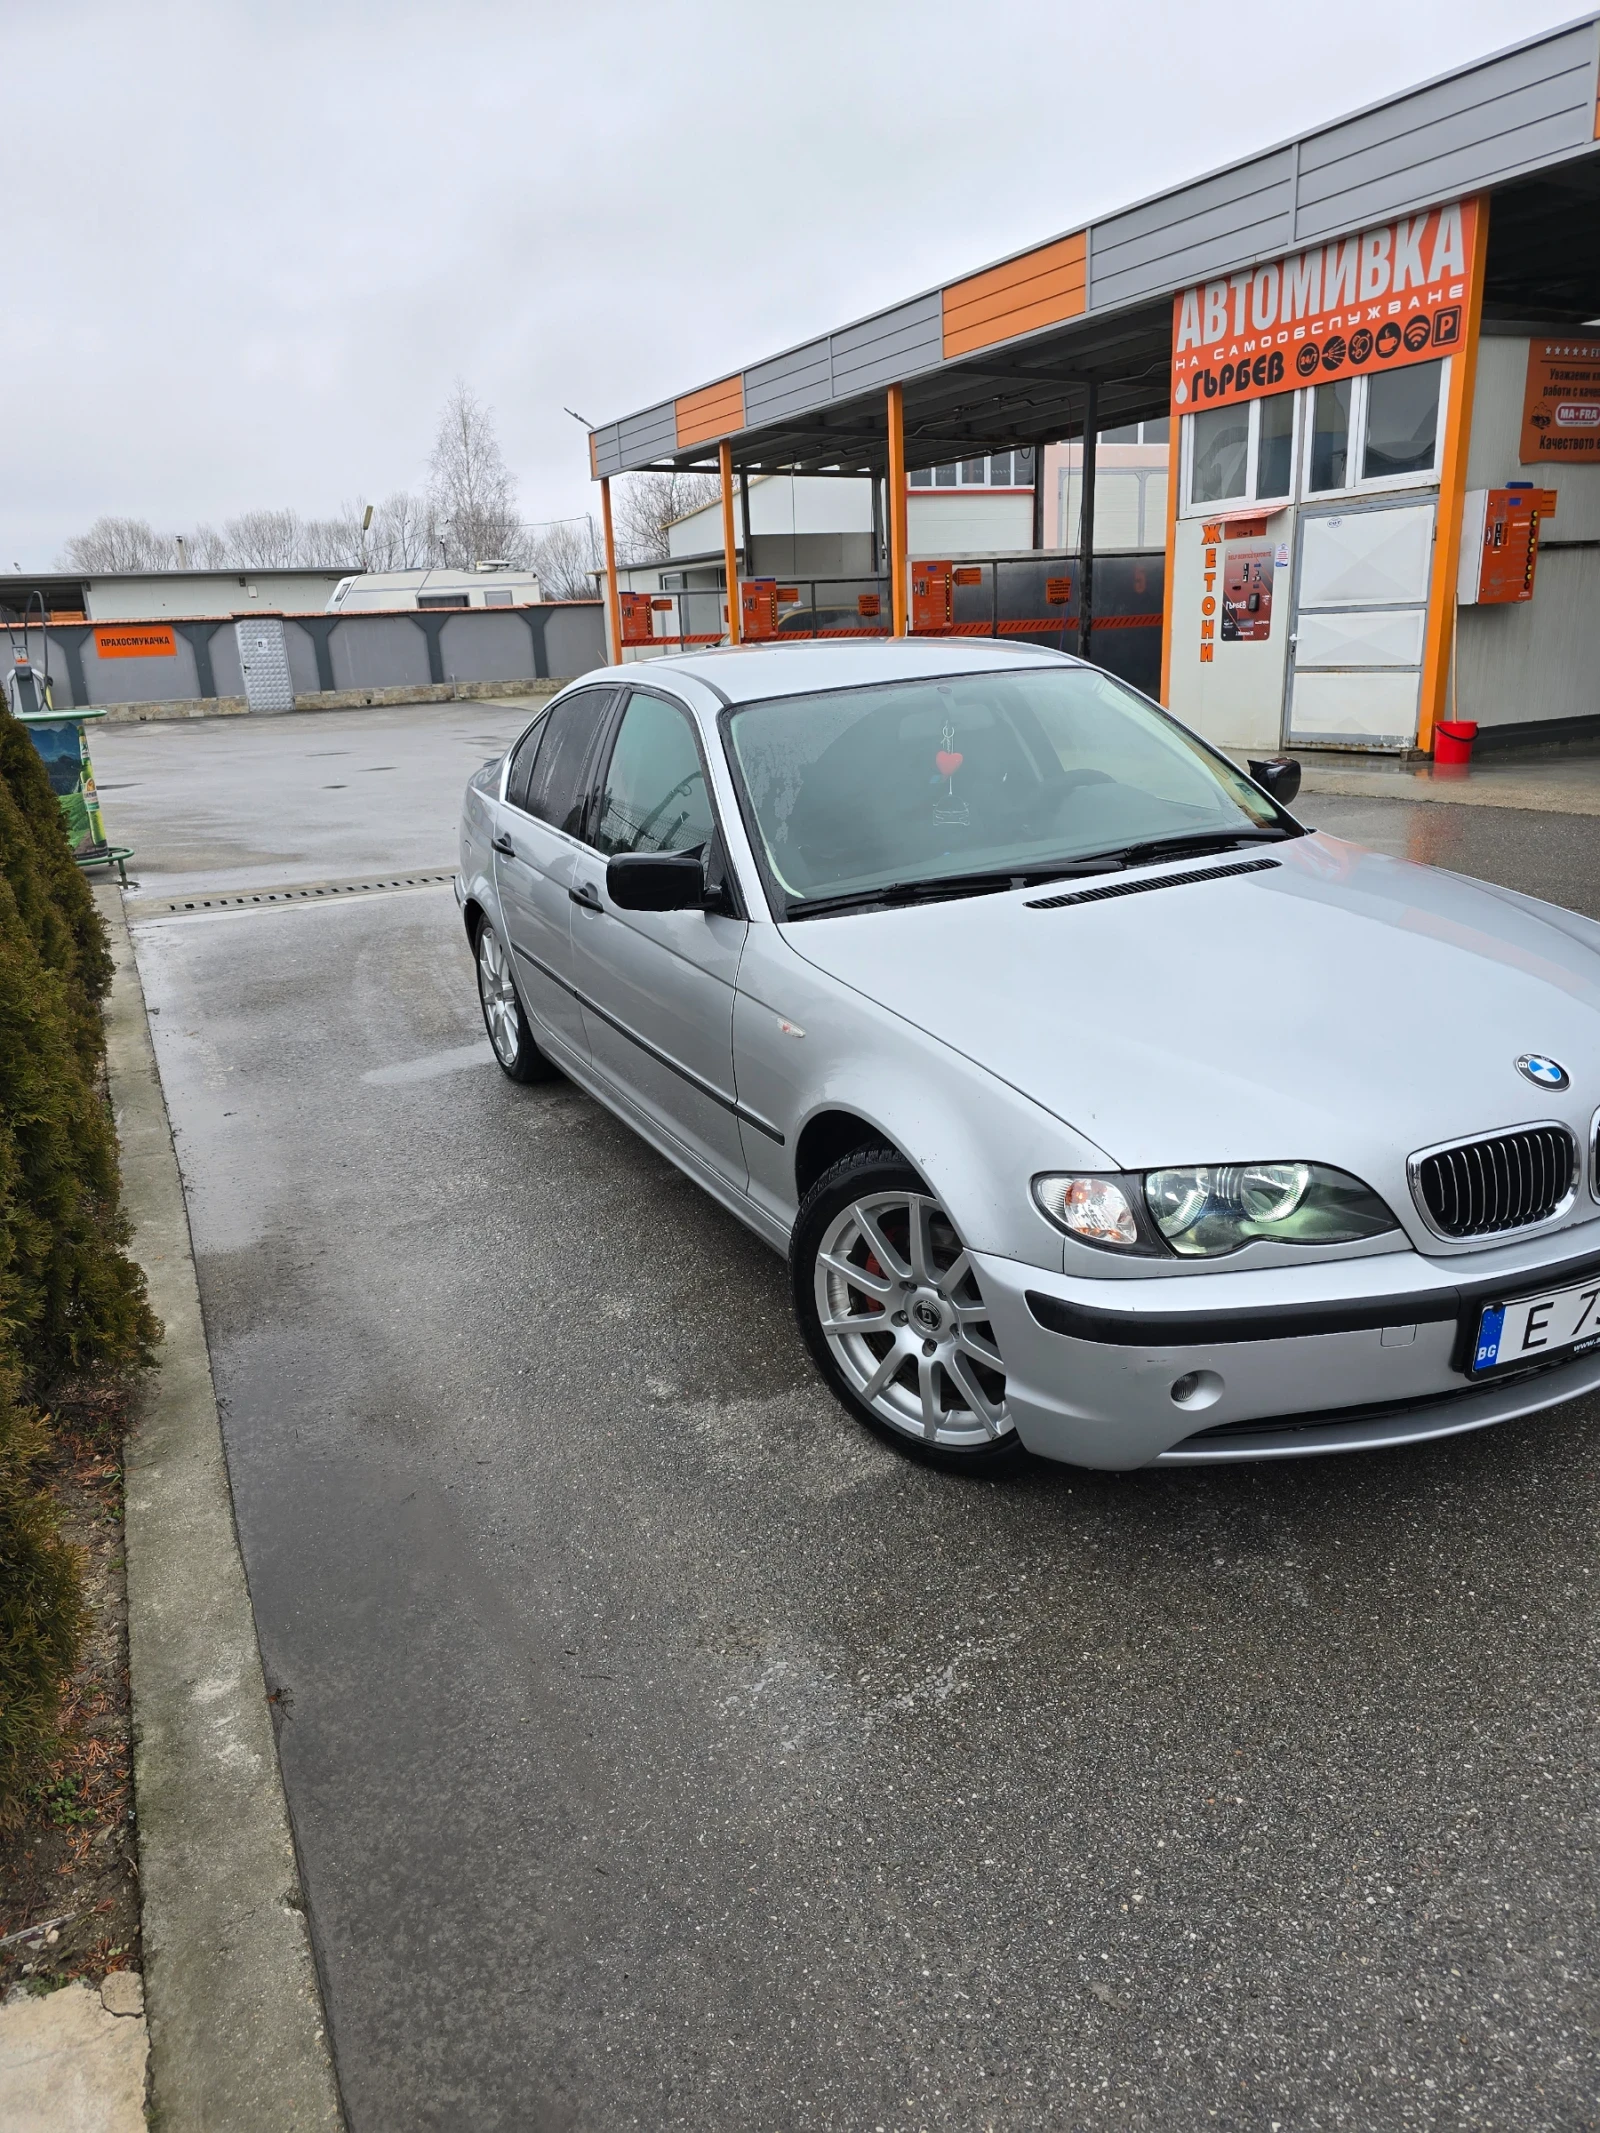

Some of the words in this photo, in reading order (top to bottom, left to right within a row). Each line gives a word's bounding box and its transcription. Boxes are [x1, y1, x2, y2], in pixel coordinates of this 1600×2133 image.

[1176, 202, 1465, 353] АВТОМИВКА
[1175, 355, 1199, 371] НА
[1213, 284, 1464, 360] САМООБСЛУЖВАНЕ
[1191, 351, 1285, 402] ГЪРБЕВ
[1543, 385, 1571, 398] работи
[1540, 436, 1594, 450] Качеството
[1200, 523, 1222, 662] ЖЕТОНИ
[101, 636, 170, 647] ПРАХОСМУКАЧКА
[1521, 1302, 1554, 1351] E
[1477, 1344, 1497, 1361] BG
